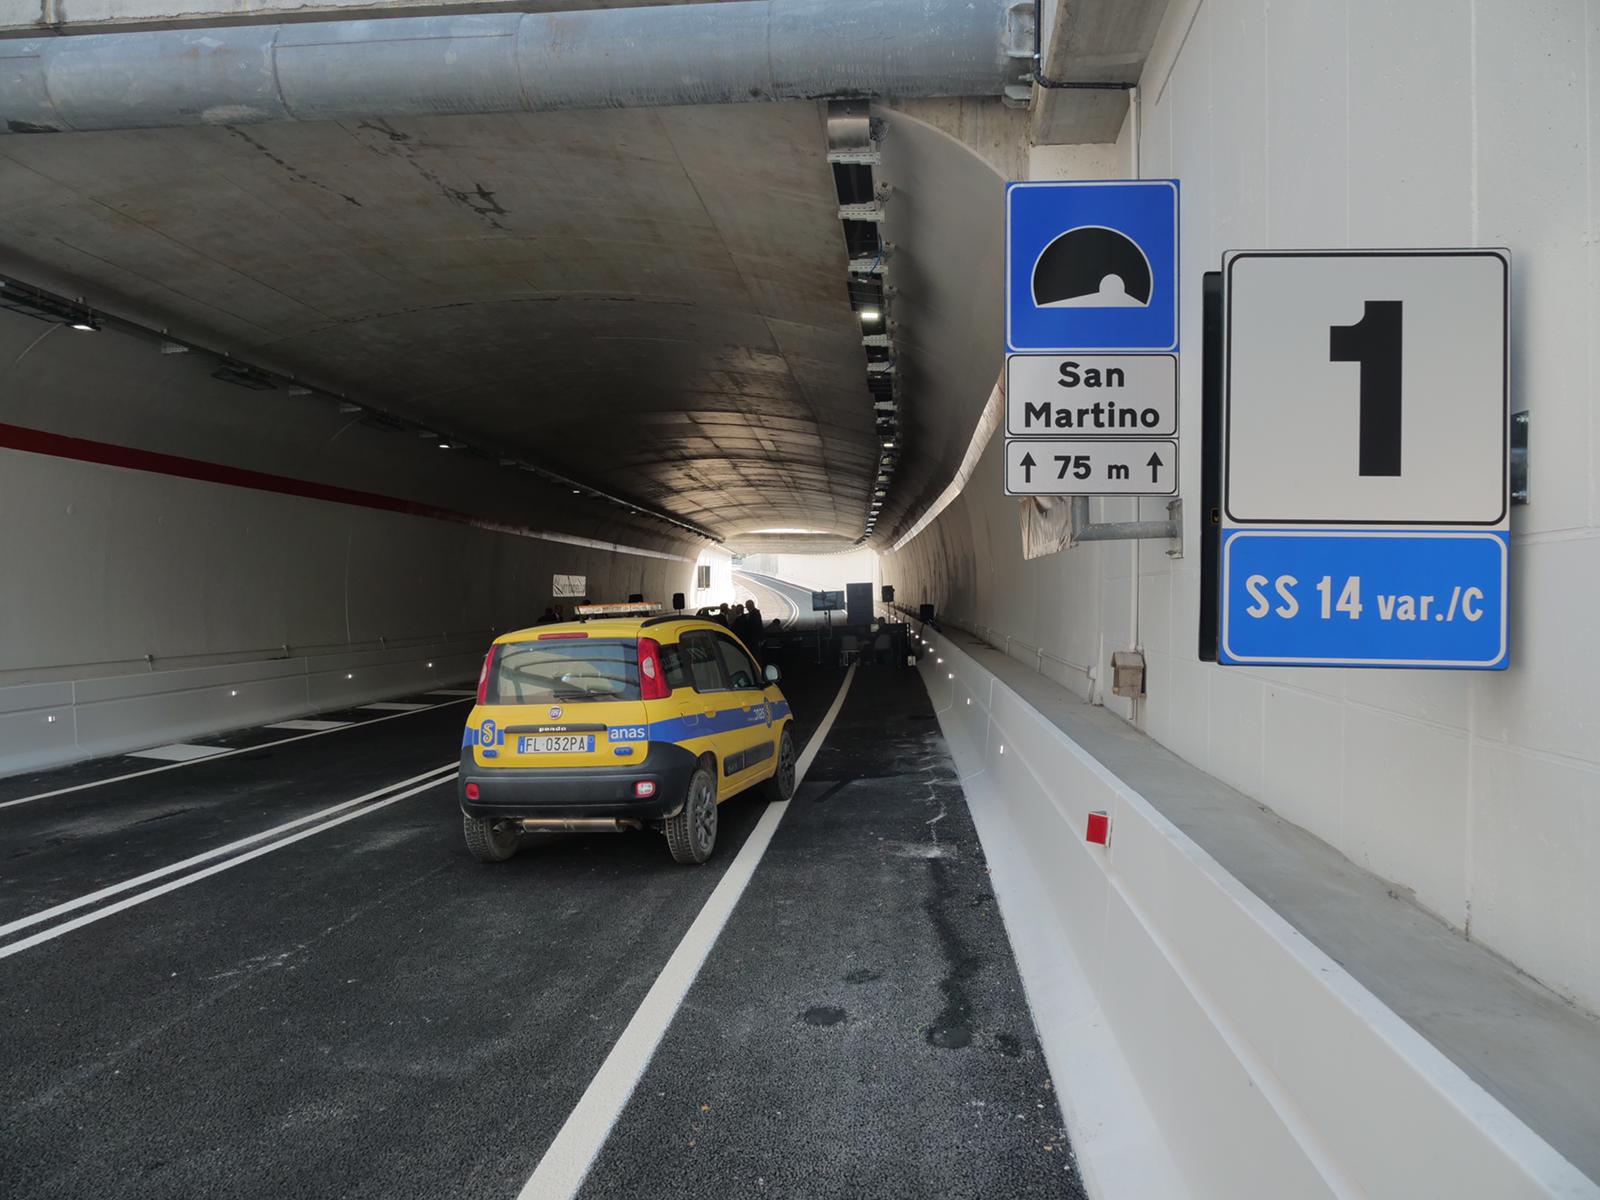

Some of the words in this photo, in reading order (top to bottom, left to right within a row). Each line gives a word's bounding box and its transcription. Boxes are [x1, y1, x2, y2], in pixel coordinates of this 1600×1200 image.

[1057, 361, 1125, 388] San
[1329, 300, 1403, 477] 1
[1024, 400, 1160, 429] Martino
[1053, 455, 1092, 480] 75
[1107, 464, 1130, 480] m
[1245, 574, 1300, 620] SS
[1316, 575, 1364, 620] 14
[1377, 586, 1485, 622] var./C
[525, 737, 541, 752] FL
[610, 727, 646, 740] anas
